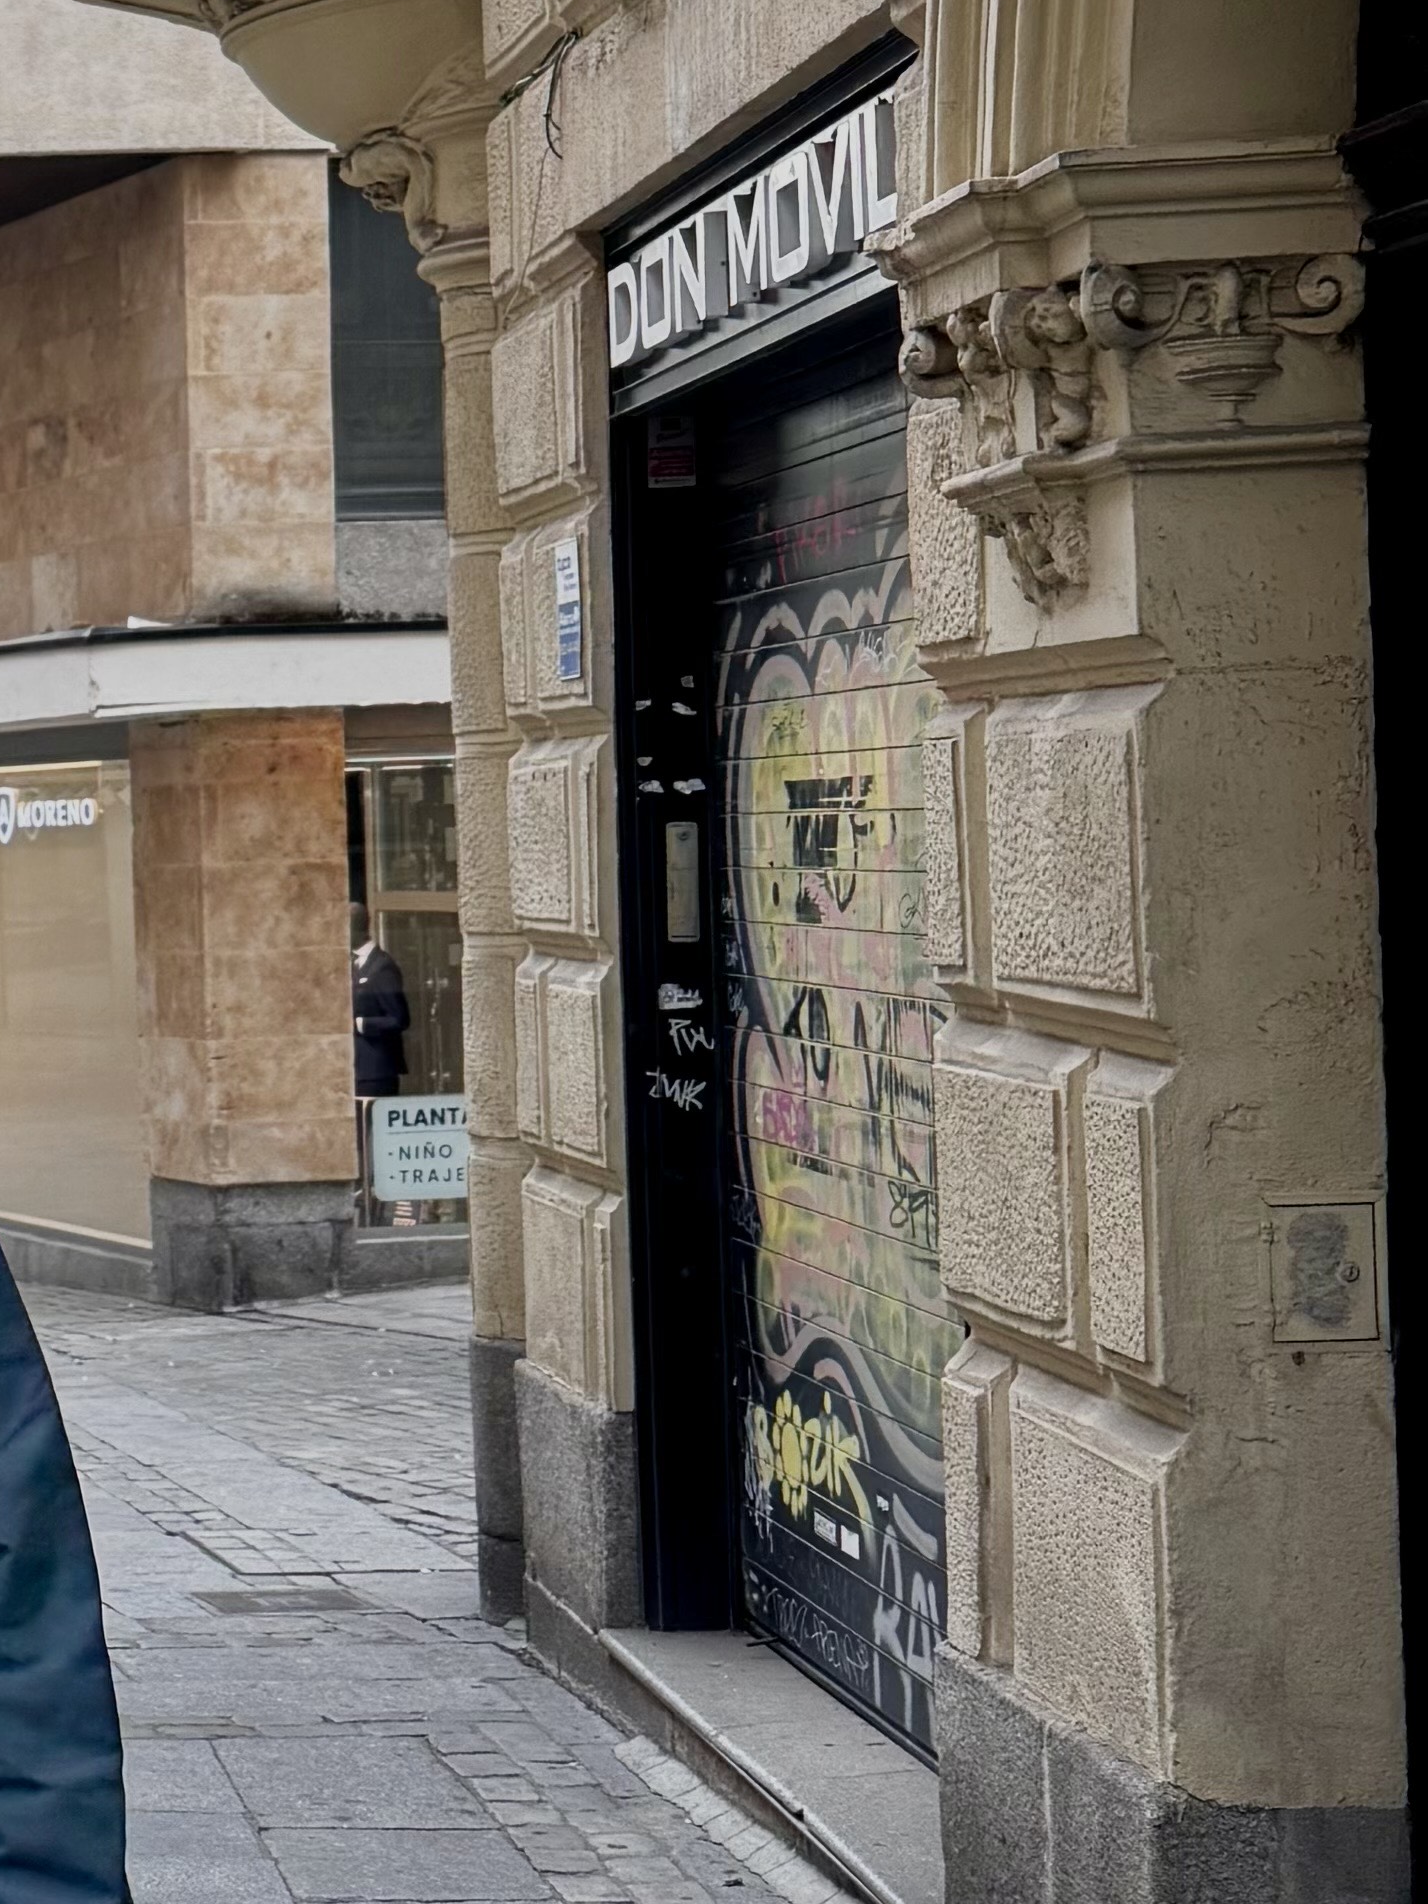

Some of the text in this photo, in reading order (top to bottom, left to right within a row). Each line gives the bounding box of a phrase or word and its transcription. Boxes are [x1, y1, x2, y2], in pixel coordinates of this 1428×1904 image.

[608, 96, 899, 369] DON MOVIL
[17, 797, 97, 828] MORENO
